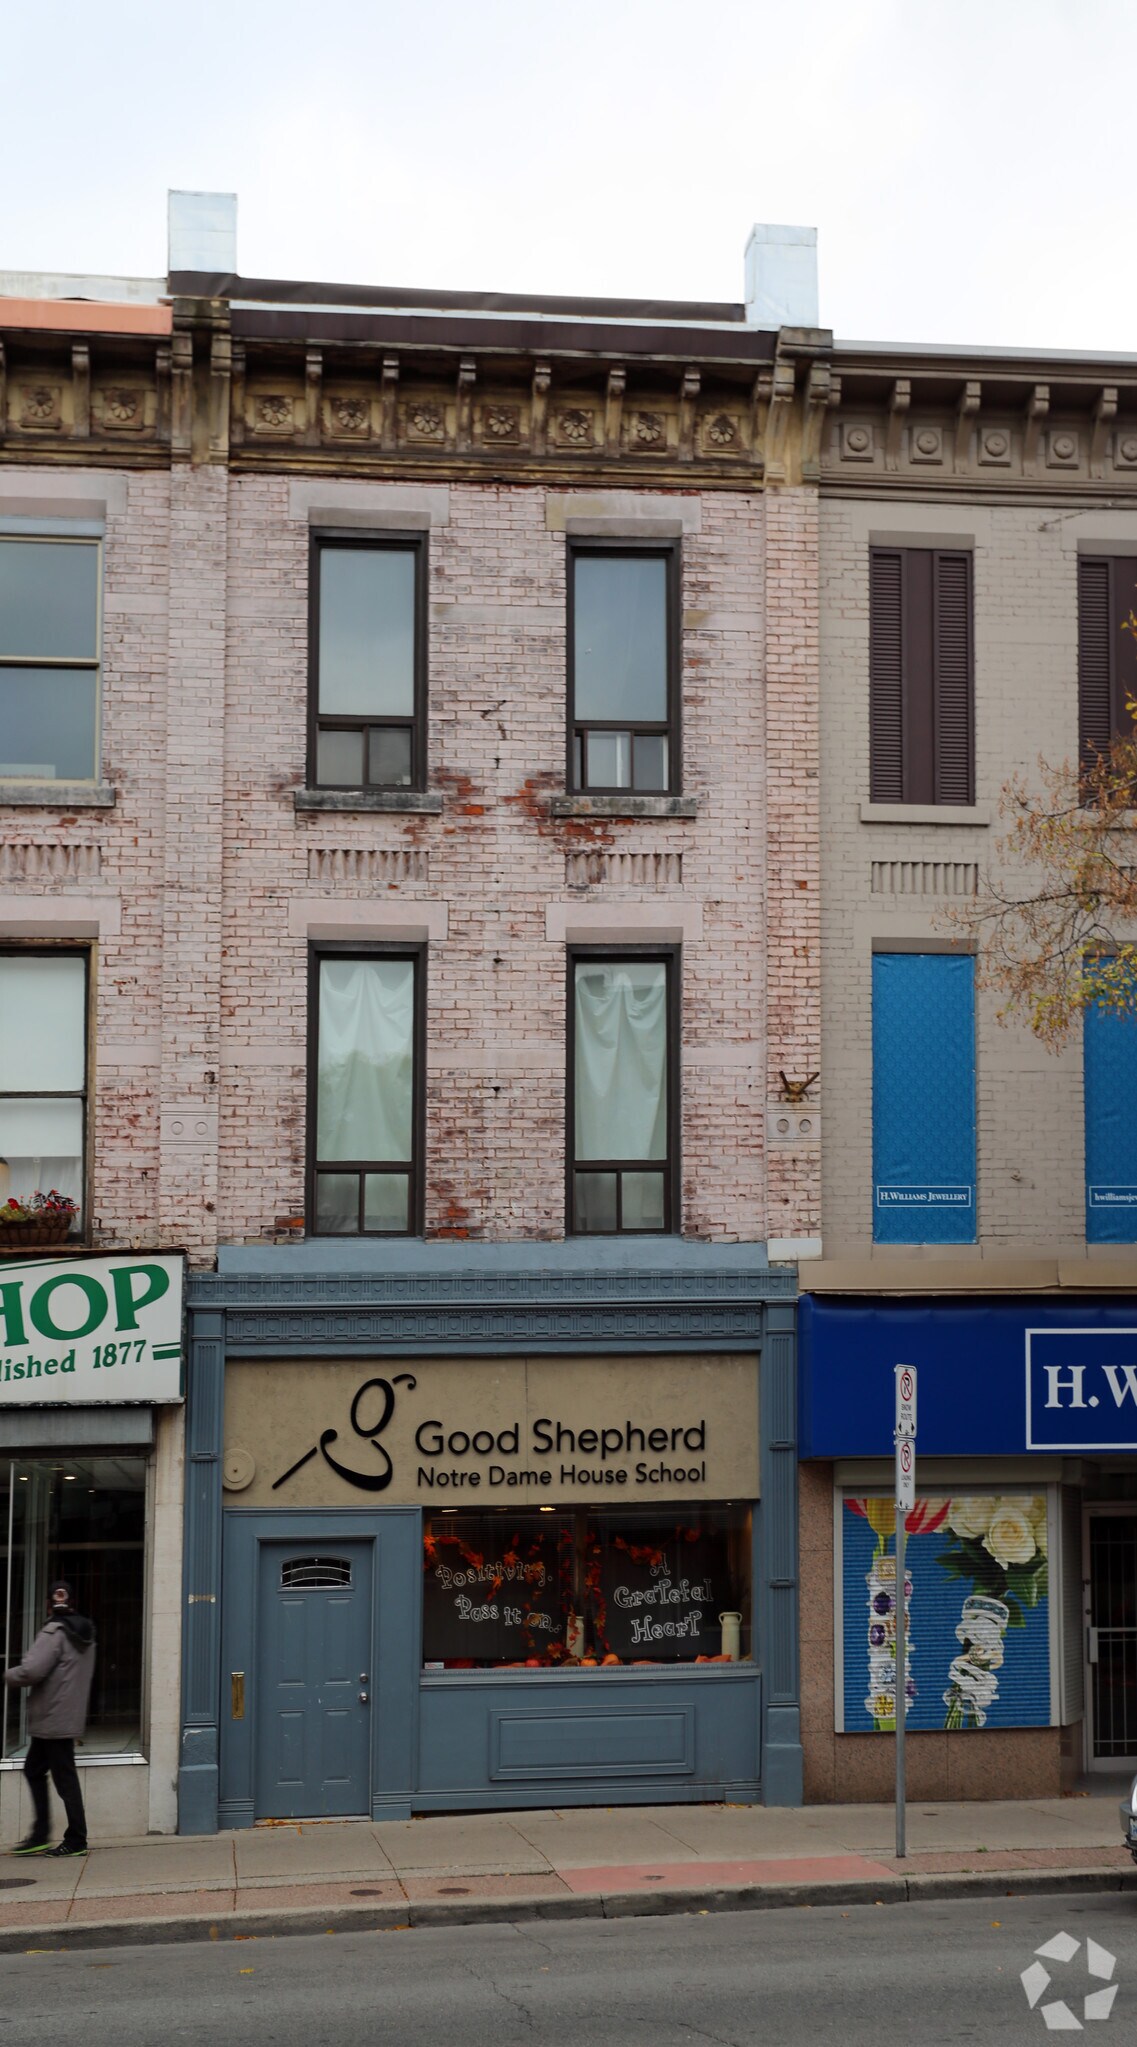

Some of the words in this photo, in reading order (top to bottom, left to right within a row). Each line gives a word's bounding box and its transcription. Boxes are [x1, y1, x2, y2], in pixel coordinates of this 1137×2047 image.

[880, 1191, 927, 1201] H.WILLIAMS
[927, 1191, 967, 1202] JEWELLERY
[92, 1339, 147, 1369] 1877
[415, 1420, 519, 1456] Good
[532, 1418, 706, 1459] Shepherd
[417, 1467, 481, 1487] Notre
[489, 1465, 552, 1486] Dame
[560, 1464, 628, 1485] House
[635, 1461, 706, 1483] School
[649, 1553, 671, 1577] A
[454, 1594, 500, 1622] Pass
[503, 1606, 522, 1626] it
[630, 1610, 703, 1644] Heart
